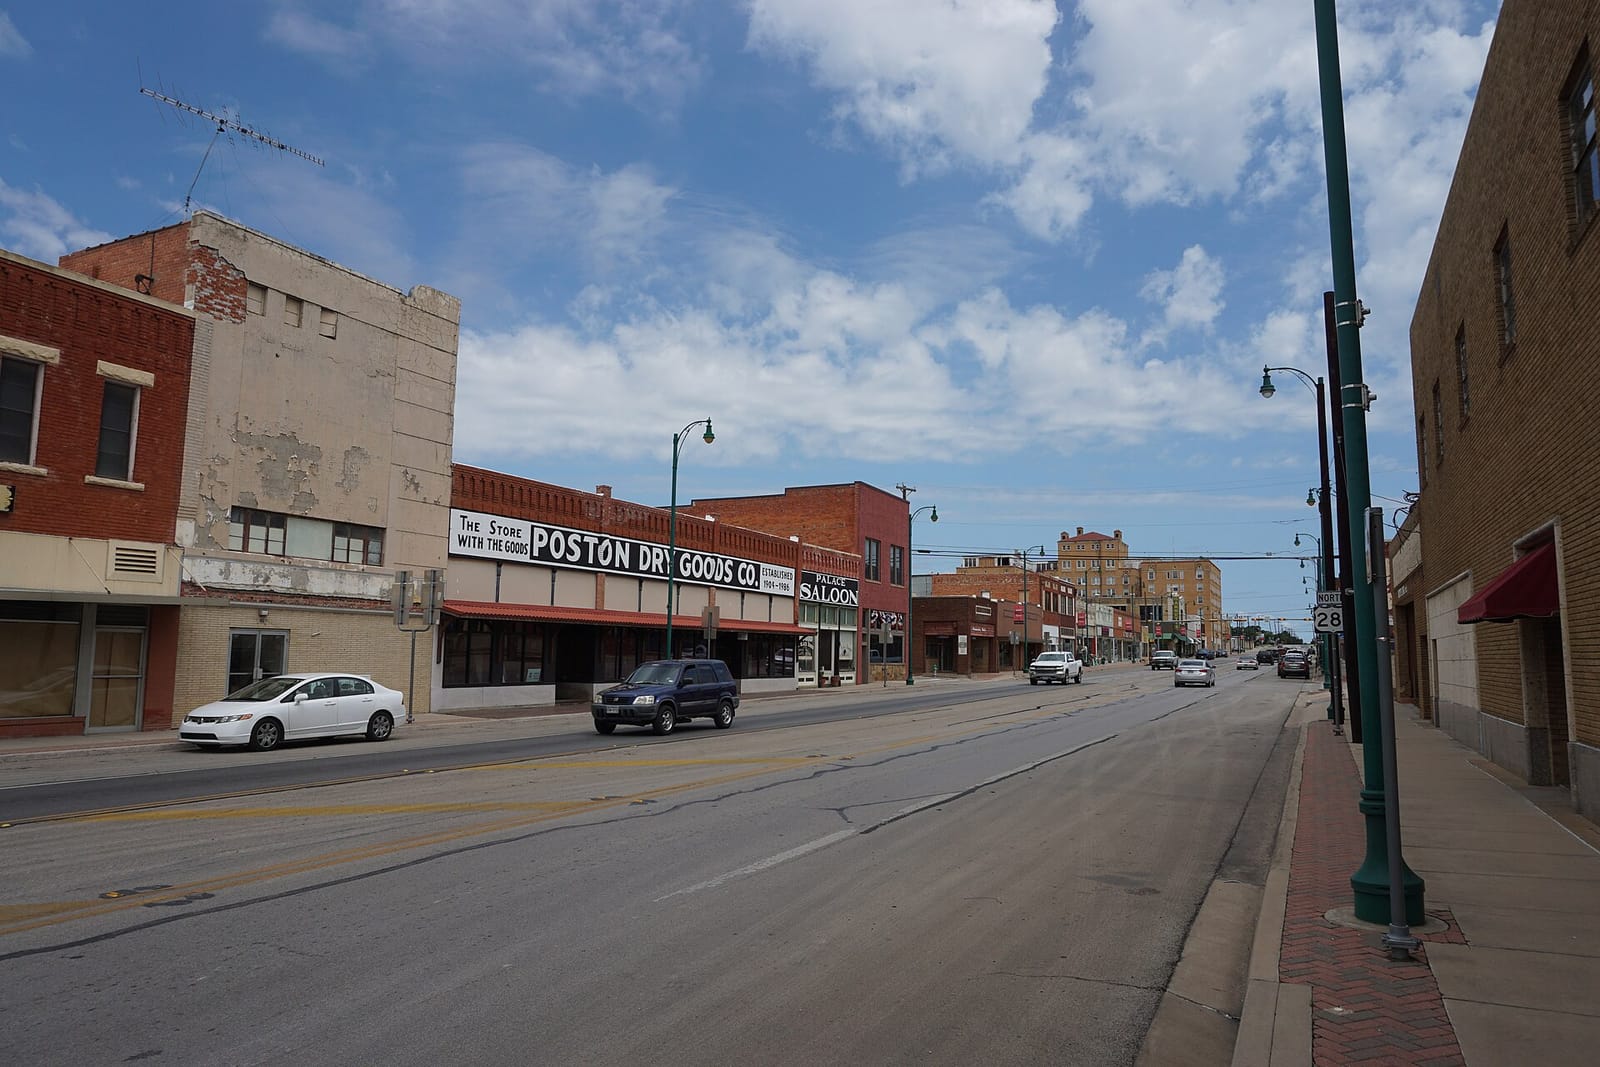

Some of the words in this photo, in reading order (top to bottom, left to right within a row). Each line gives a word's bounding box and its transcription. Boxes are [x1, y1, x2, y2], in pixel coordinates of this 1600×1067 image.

[458, 534, 484, 550] WITH
[487, 537, 503, 552] THE
[504, 540, 529, 555] GOODS
[532, 526, 630, 569] POSTON
[639, 545, 675, 575] DRY
[679, 552, 733, 583] GOODS
[737, 562, 759, 587] CO.
[762, 567, 793, 581] ESTABLISHED
[816, 574, 846, 587] PALACE
[800, 582, 858, 605] SALOON
[1318, 593, 1341, 602] NORT
